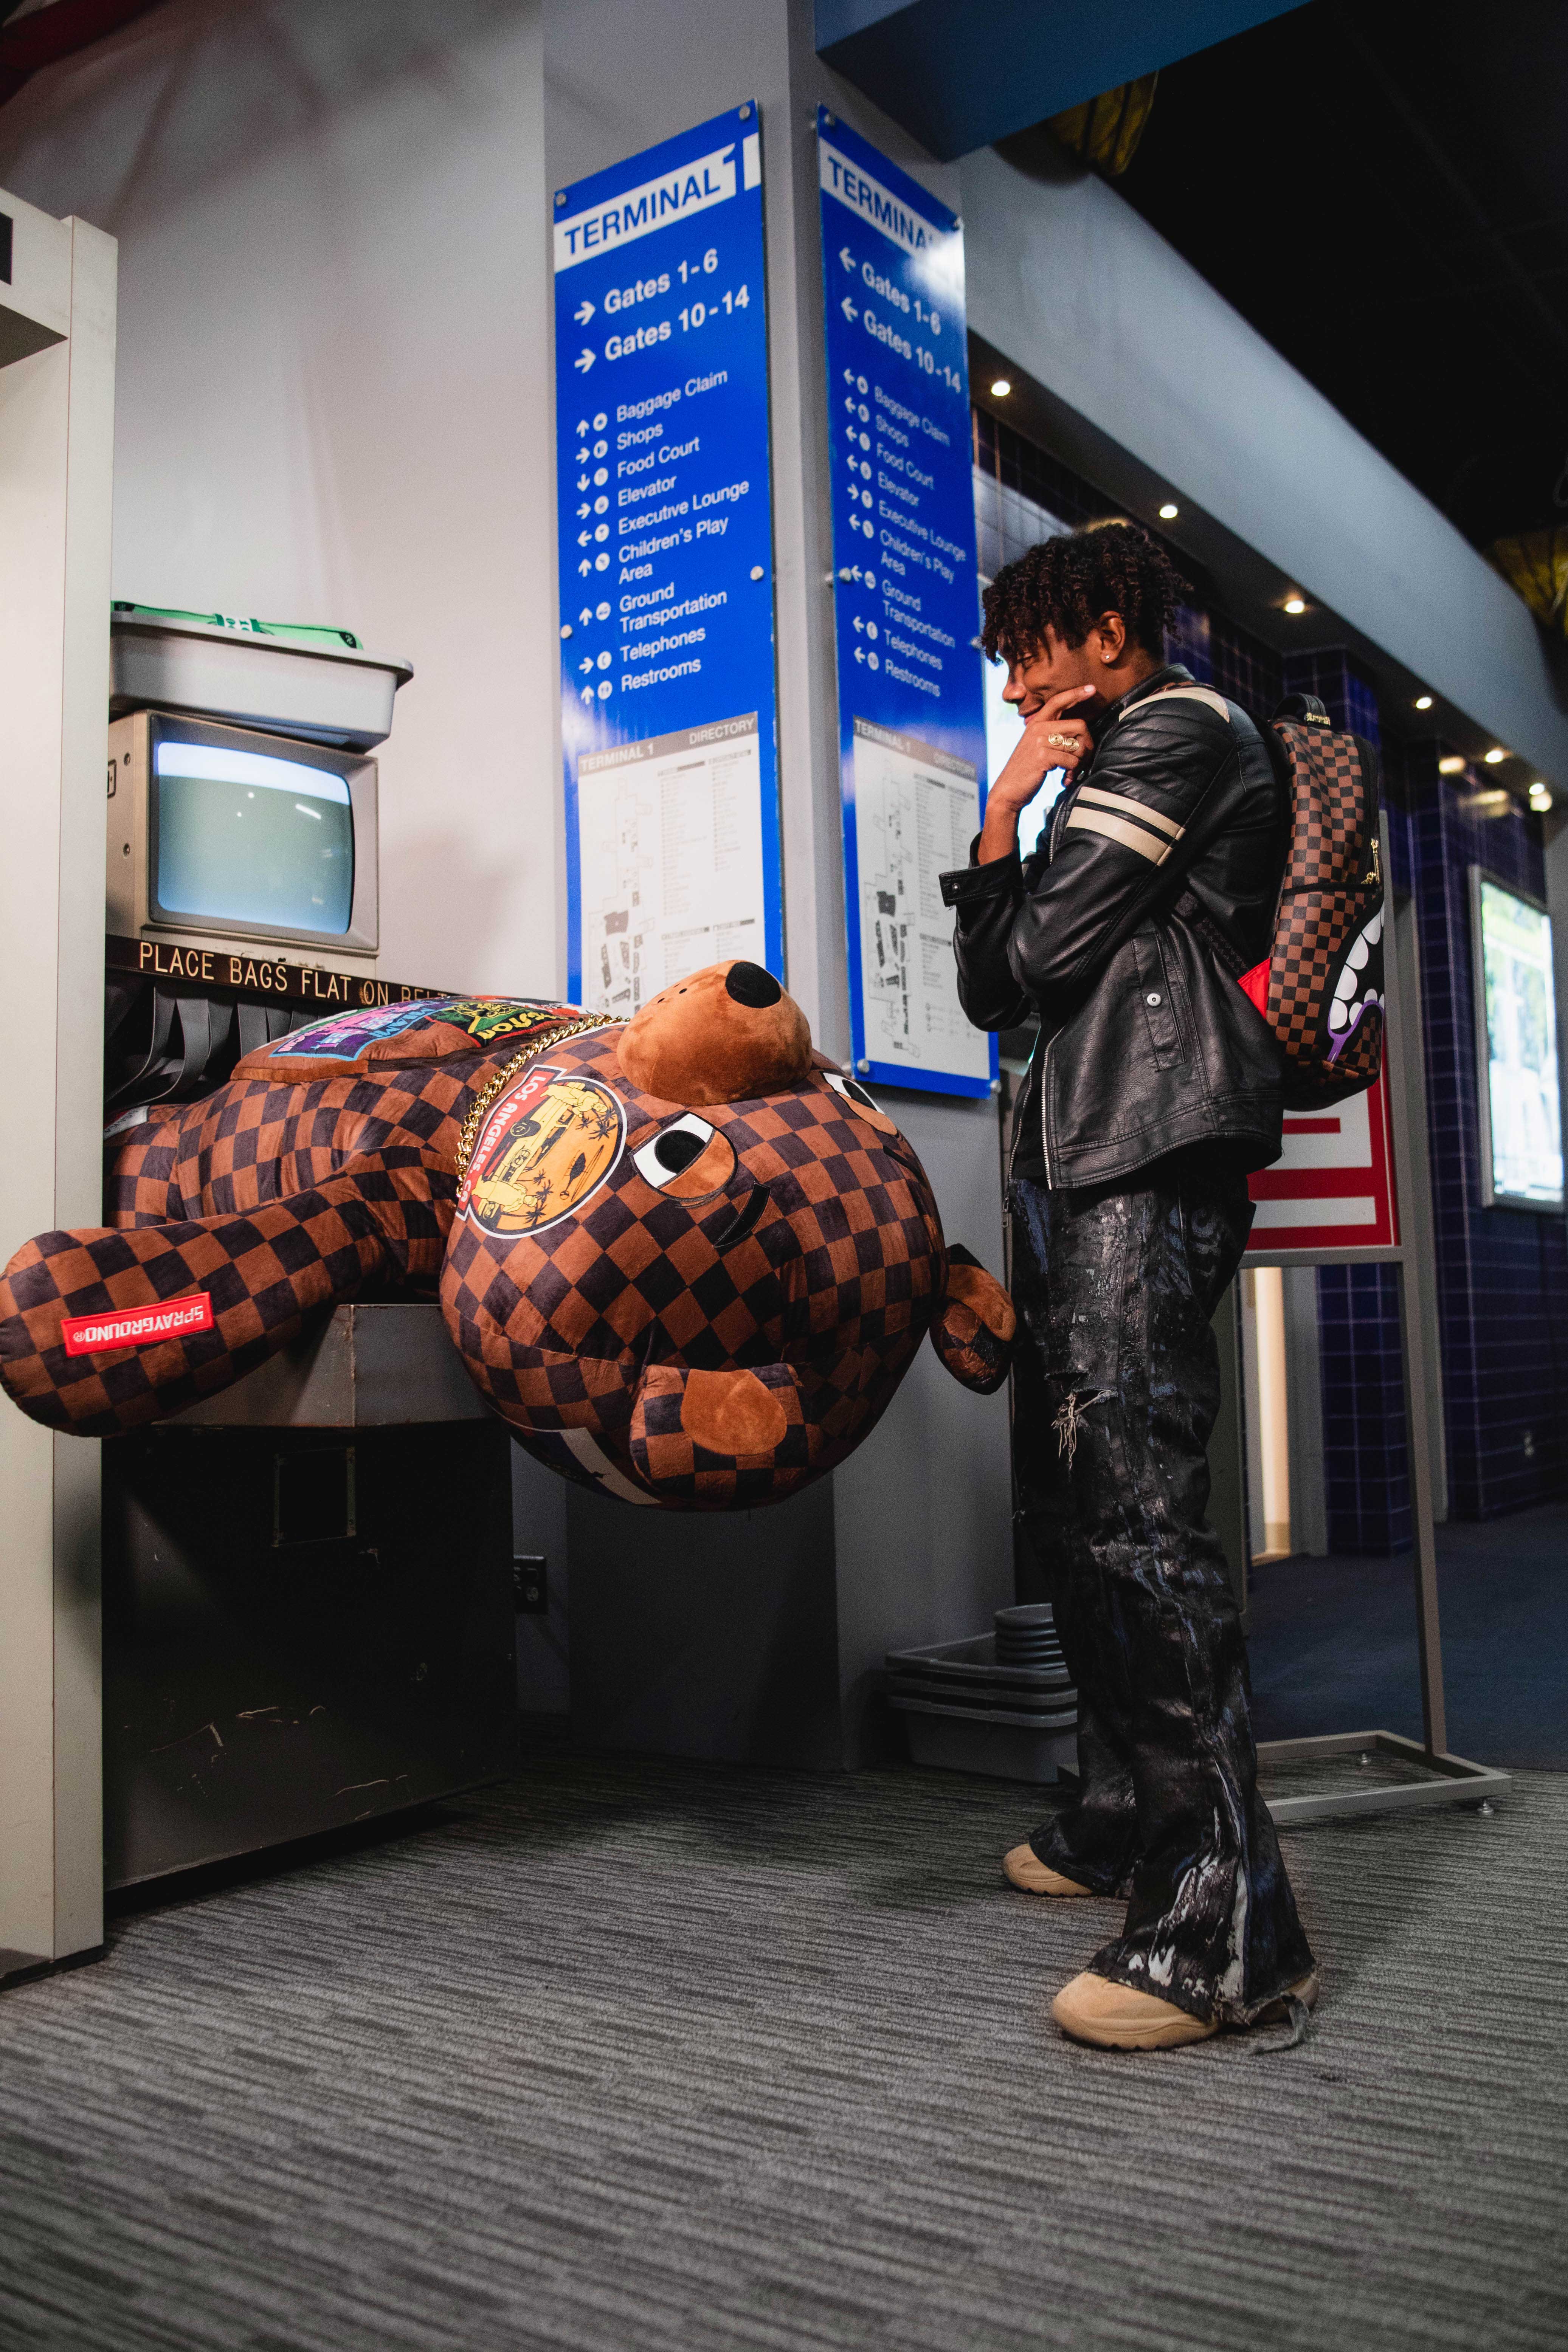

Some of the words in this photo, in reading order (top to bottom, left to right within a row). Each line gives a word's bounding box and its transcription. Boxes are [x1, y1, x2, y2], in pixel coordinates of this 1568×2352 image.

[565, 167, 720, 255] TERMINAL
[828, 155, 933, 250] TERMINA
[604, 273, 671, 315] Gates
[862, 262, 910, 314] Gates
[605, 321, 672, 361] Gates
[864, 310, 912, 360] Gates
[617, 388, 681, 422] Baggage
[684, 371, 728, 397] Claim
[617, 423, 664, 450] Shops
[617, 452, 654, 478] Food
[658, 436, 699, 464] Court
[618, 476, 677, 507] Elevator
[618, 501, 689, 535] Executive
[692, 481, 749, 511] Lounge
[619, 528, 692, 563] Children's
[696, 517, 729, 538] Play
[619, 563, 653, 585] Area
[619, 582, 675, 613] Ground
[620, 591, 727, 633] Transportation
[882, 579, 921, 612] Ground
[620, 627, 706, 662] Telephones
[884, 629, 943, 671] Telephones
[621, 659, 701, 692] Restrooms
[885, 659, 940, 697] Restrooms
[581, 747, 644, 772] TERMINAL
[647, 743, 654, 755] 1
[690, 718, 755, 745] DIRECTORY
[140, 942, 214, 980] PLACE
[230, 957, 287, 991] BAGS
[302, 970, 351, 1001] FLAT
[363, 980, 389, 1006] ON
[368, 1008, 436, 1038] MIAMI
[515, 1076, 547, 1101] LOS
[460, 1180, 471, 1202] CA
